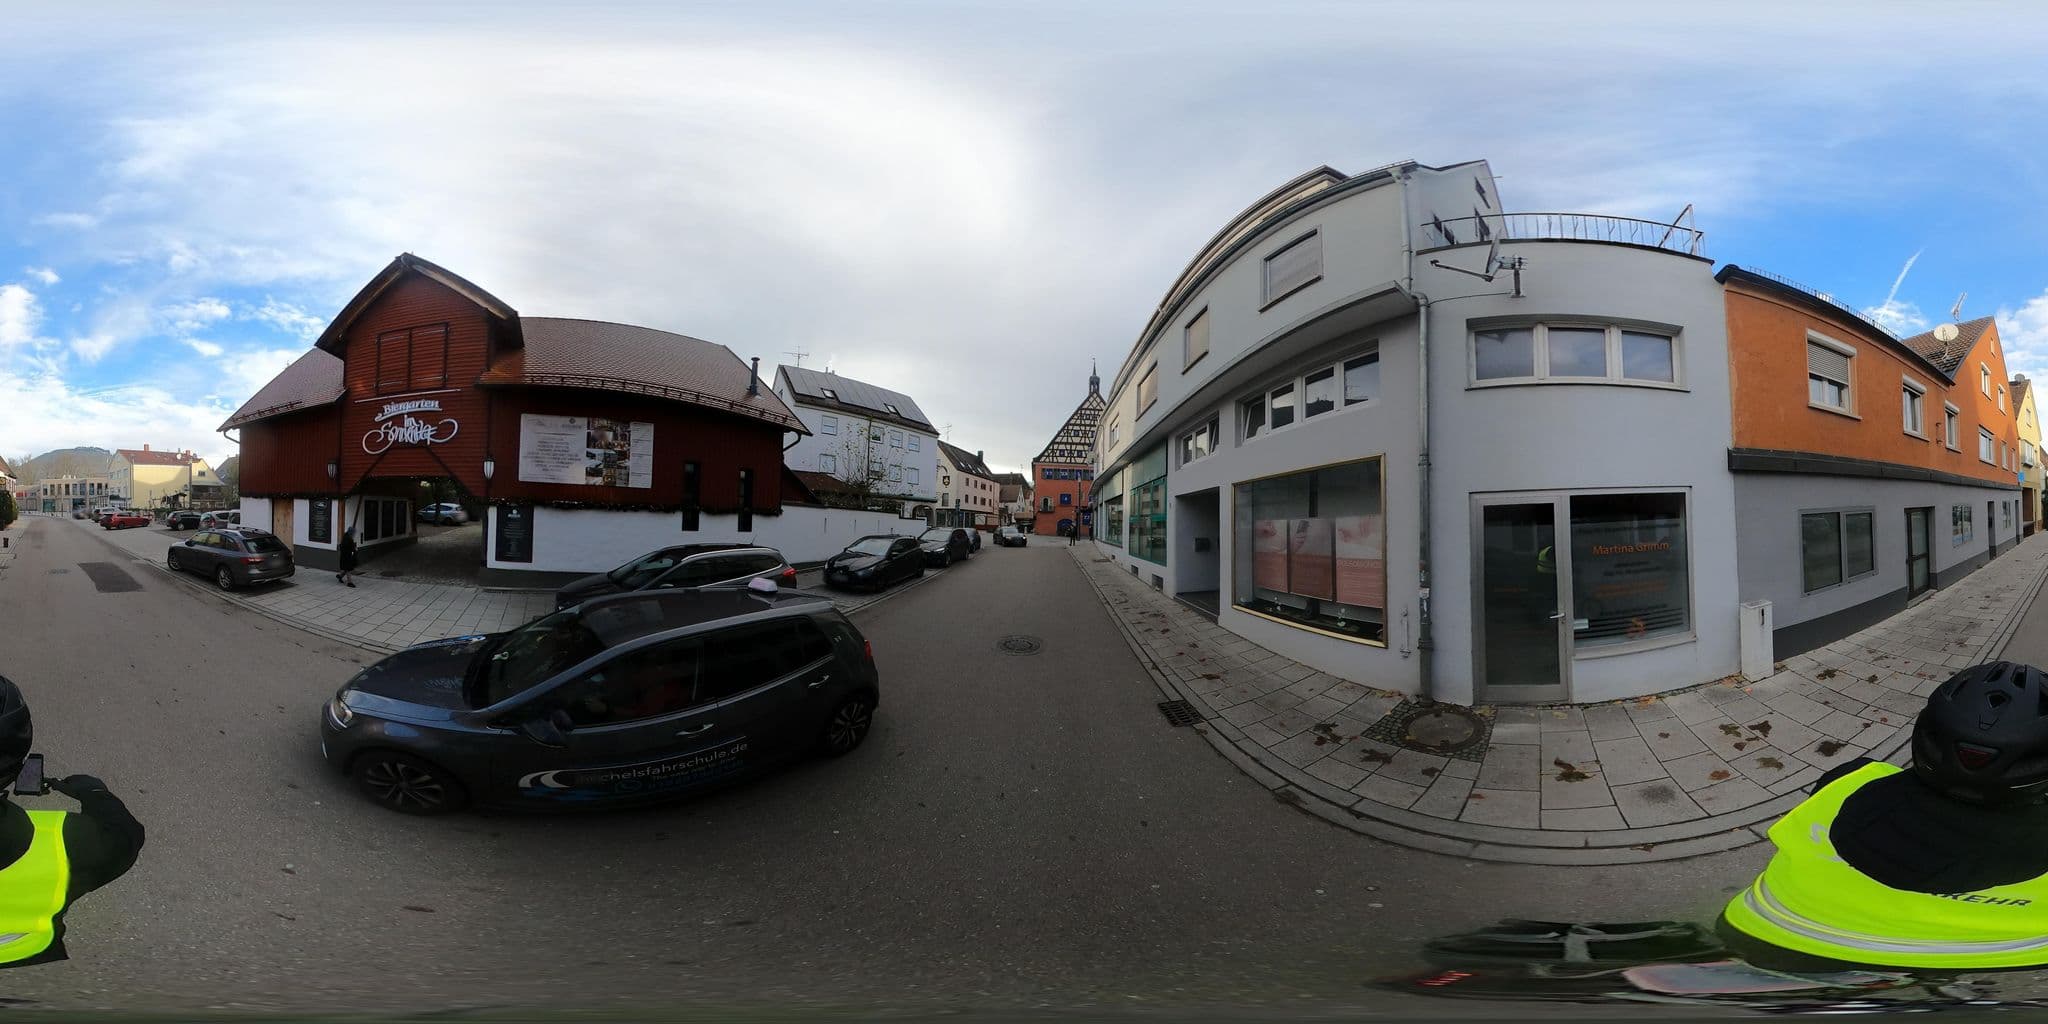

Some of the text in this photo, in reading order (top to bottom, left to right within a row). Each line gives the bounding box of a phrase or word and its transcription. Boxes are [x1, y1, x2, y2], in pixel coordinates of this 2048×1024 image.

[382, 399, 440, 415] Biergarten
[1592, 541, 1670, 556] Martina Grimm
[1934, 892, 2032, 907] KEHR
